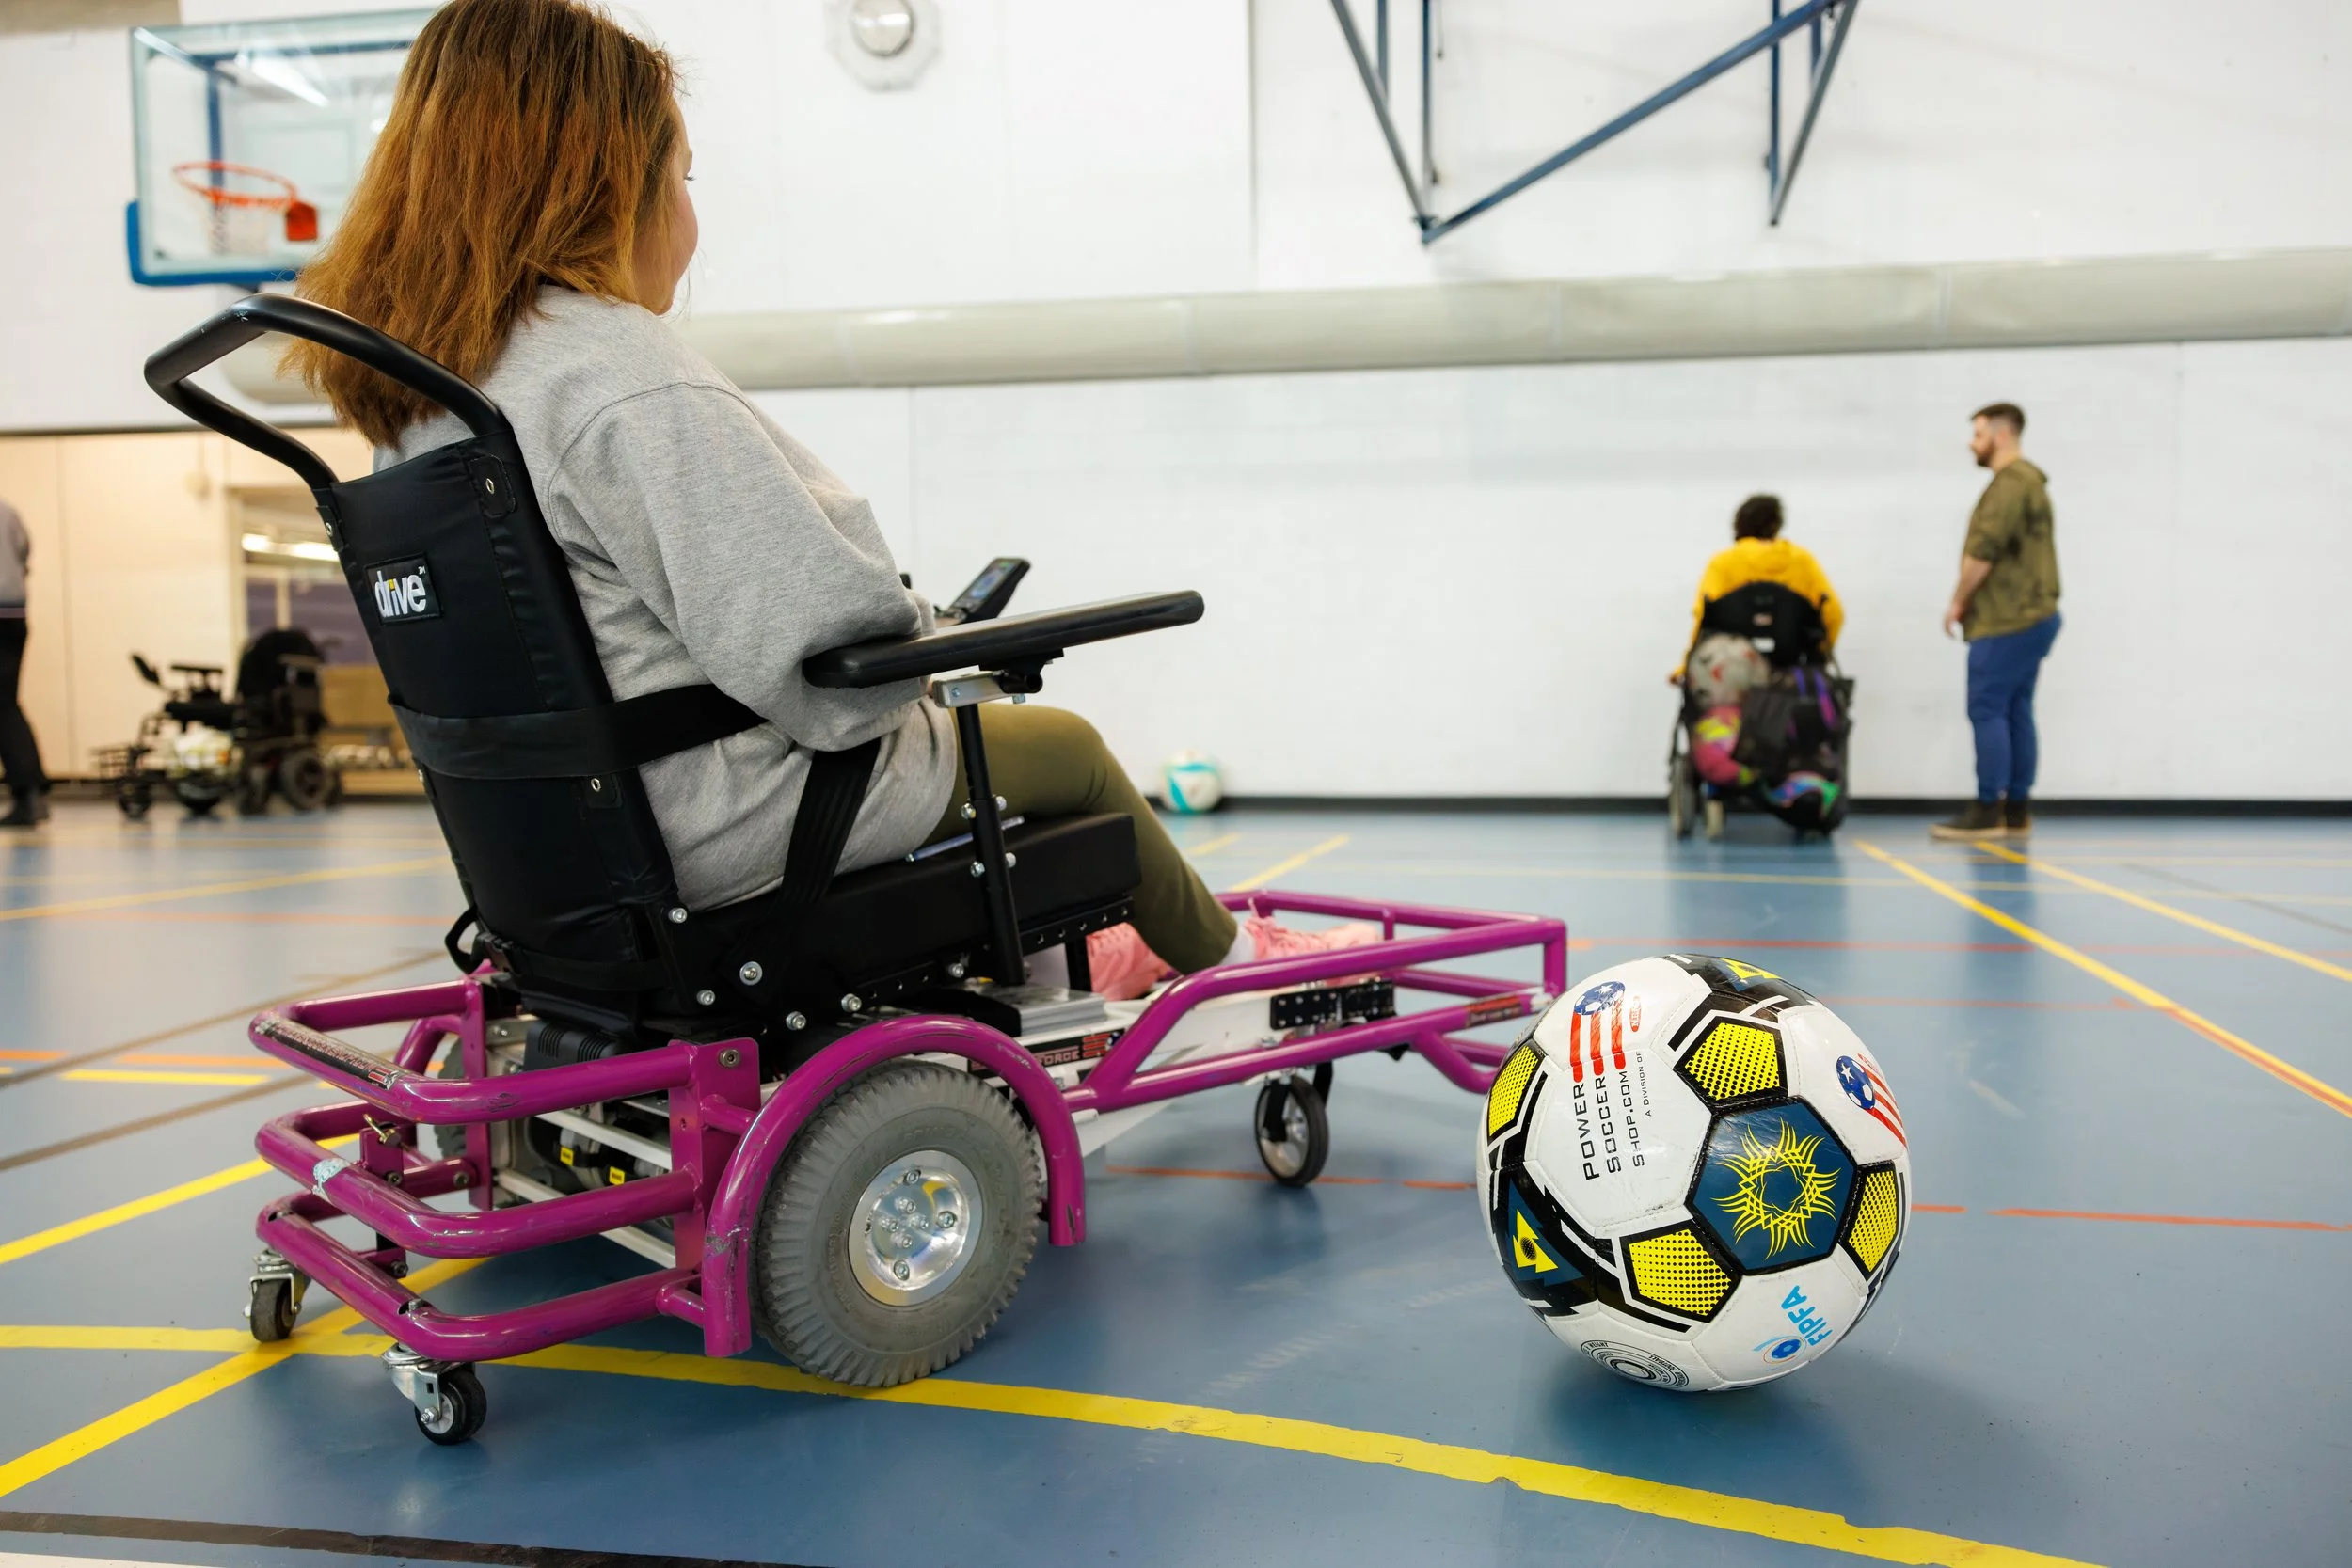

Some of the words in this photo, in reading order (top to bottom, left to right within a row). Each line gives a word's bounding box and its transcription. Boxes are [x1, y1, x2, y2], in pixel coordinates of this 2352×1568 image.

[374, 570, 427, 618] drive
[1595, 1076, 1622, 1173] SOCCER
[1618, 1070, 1645, 1167] SHOP.COM
[1638, 1066, 1650, 1106] DIVISION
[1573, 1083, 1600, 1180] POWER
[1781, 1285, 1833, 1346] FIPFA
